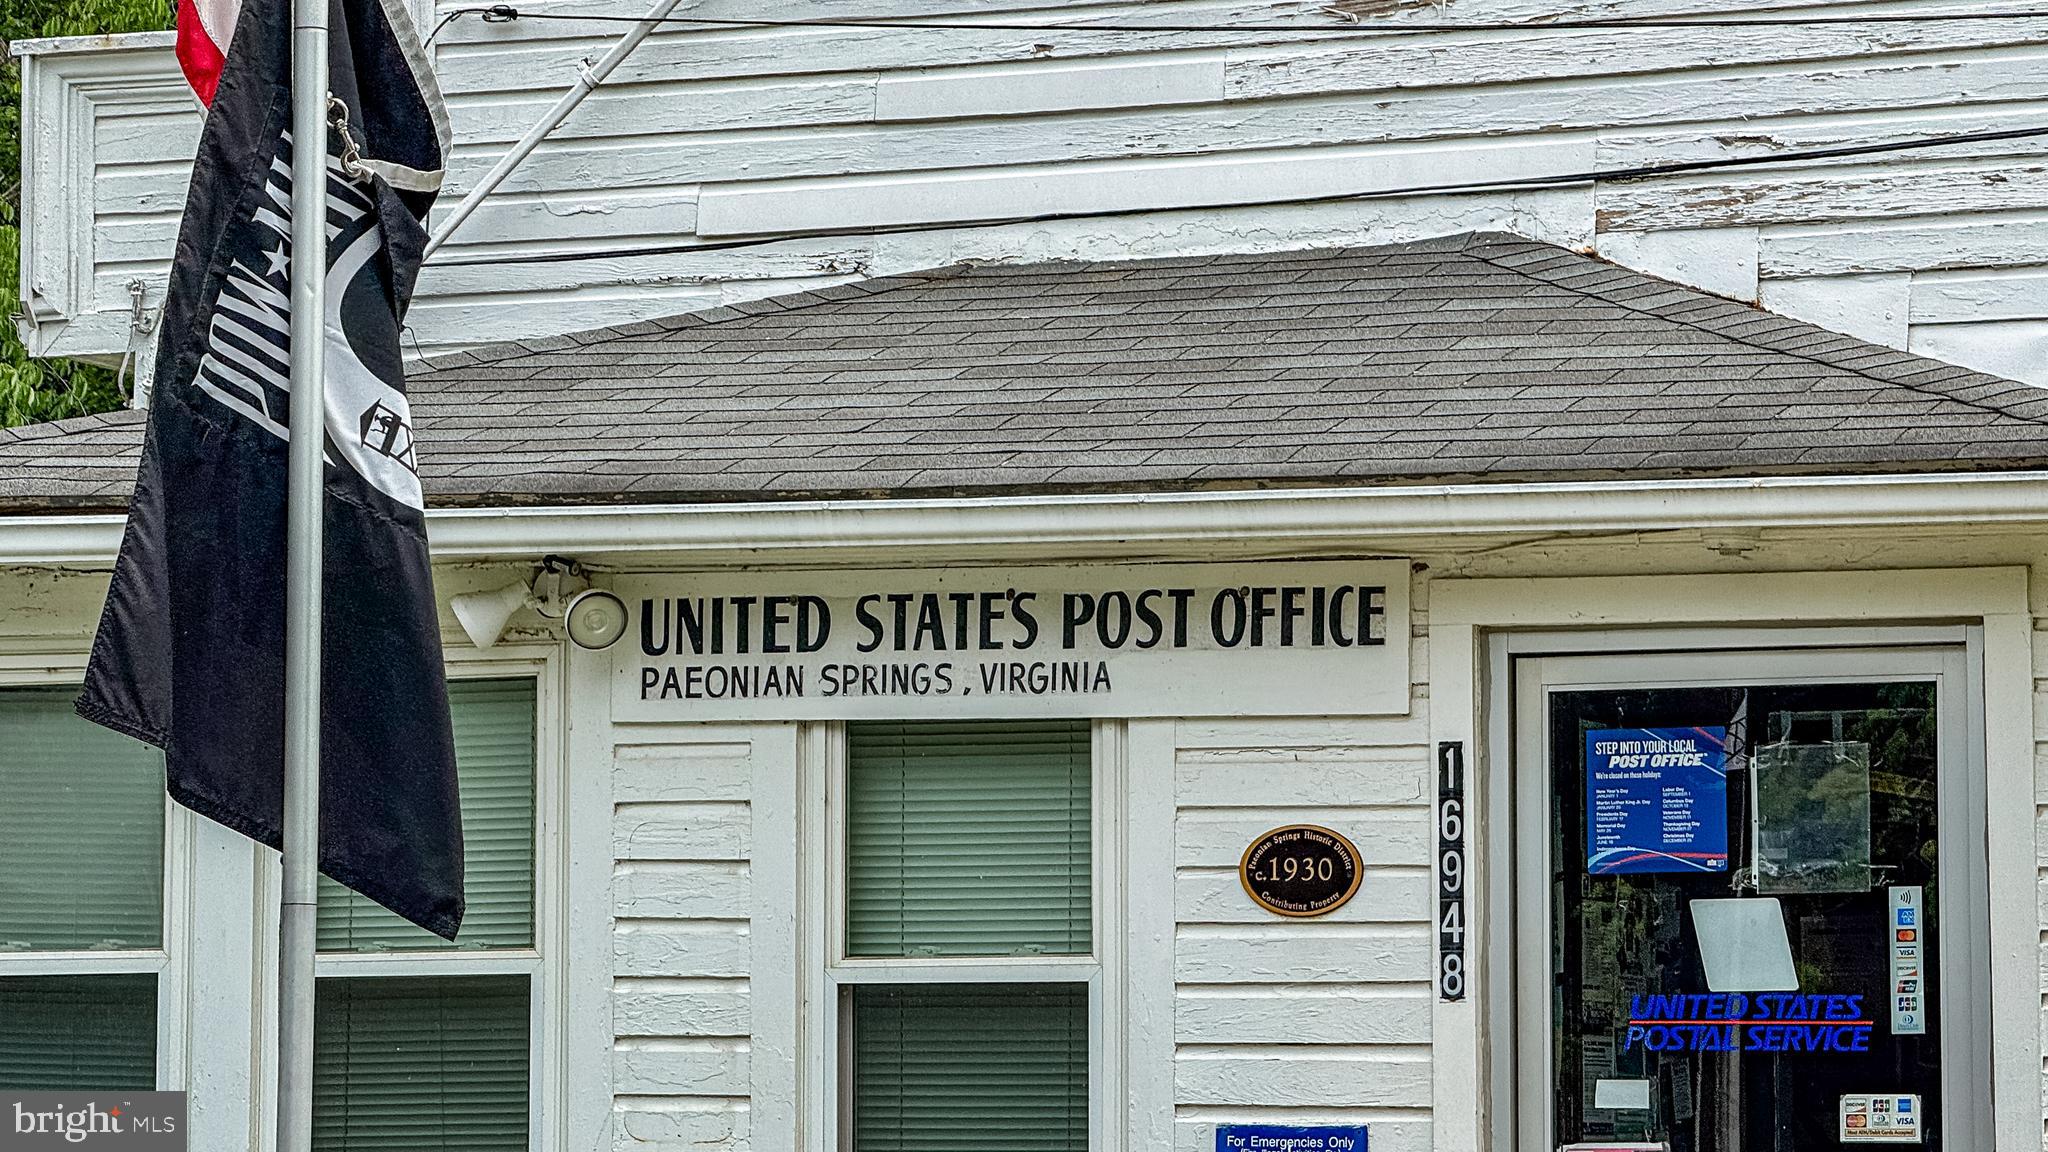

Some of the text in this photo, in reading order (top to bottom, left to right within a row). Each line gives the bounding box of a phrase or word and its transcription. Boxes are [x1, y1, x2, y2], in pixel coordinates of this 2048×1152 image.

[640, 594, 831, 656] UNITED
[1062, 588, 1195, 649] POST
[1210, 585, 1386, 648] OFFICE
[640, 664, 804, 700] PAEONIAN
[979, 660, 1112, 695] VIRGINIA
[1595, 739, 1697, 755] STEP INTO YOUR LOCAL
[1608, 753, 1704, 768] POST OFFICE
[1248, 830, 1352, 870] Paeonian Springs Historic District
[1440, 747, 1464, 996] 16948
[1261, 891, 1340, 911] Contributing Property
[1630, 993, 1864, 1020] UNITED STATES
[1623, 1025, 1873, 1051] POSTAL SERVICE
[1896, 1117, 1915, 1125] VISA
[1227, 1135, 1355, 1150] For Emergencies Only
